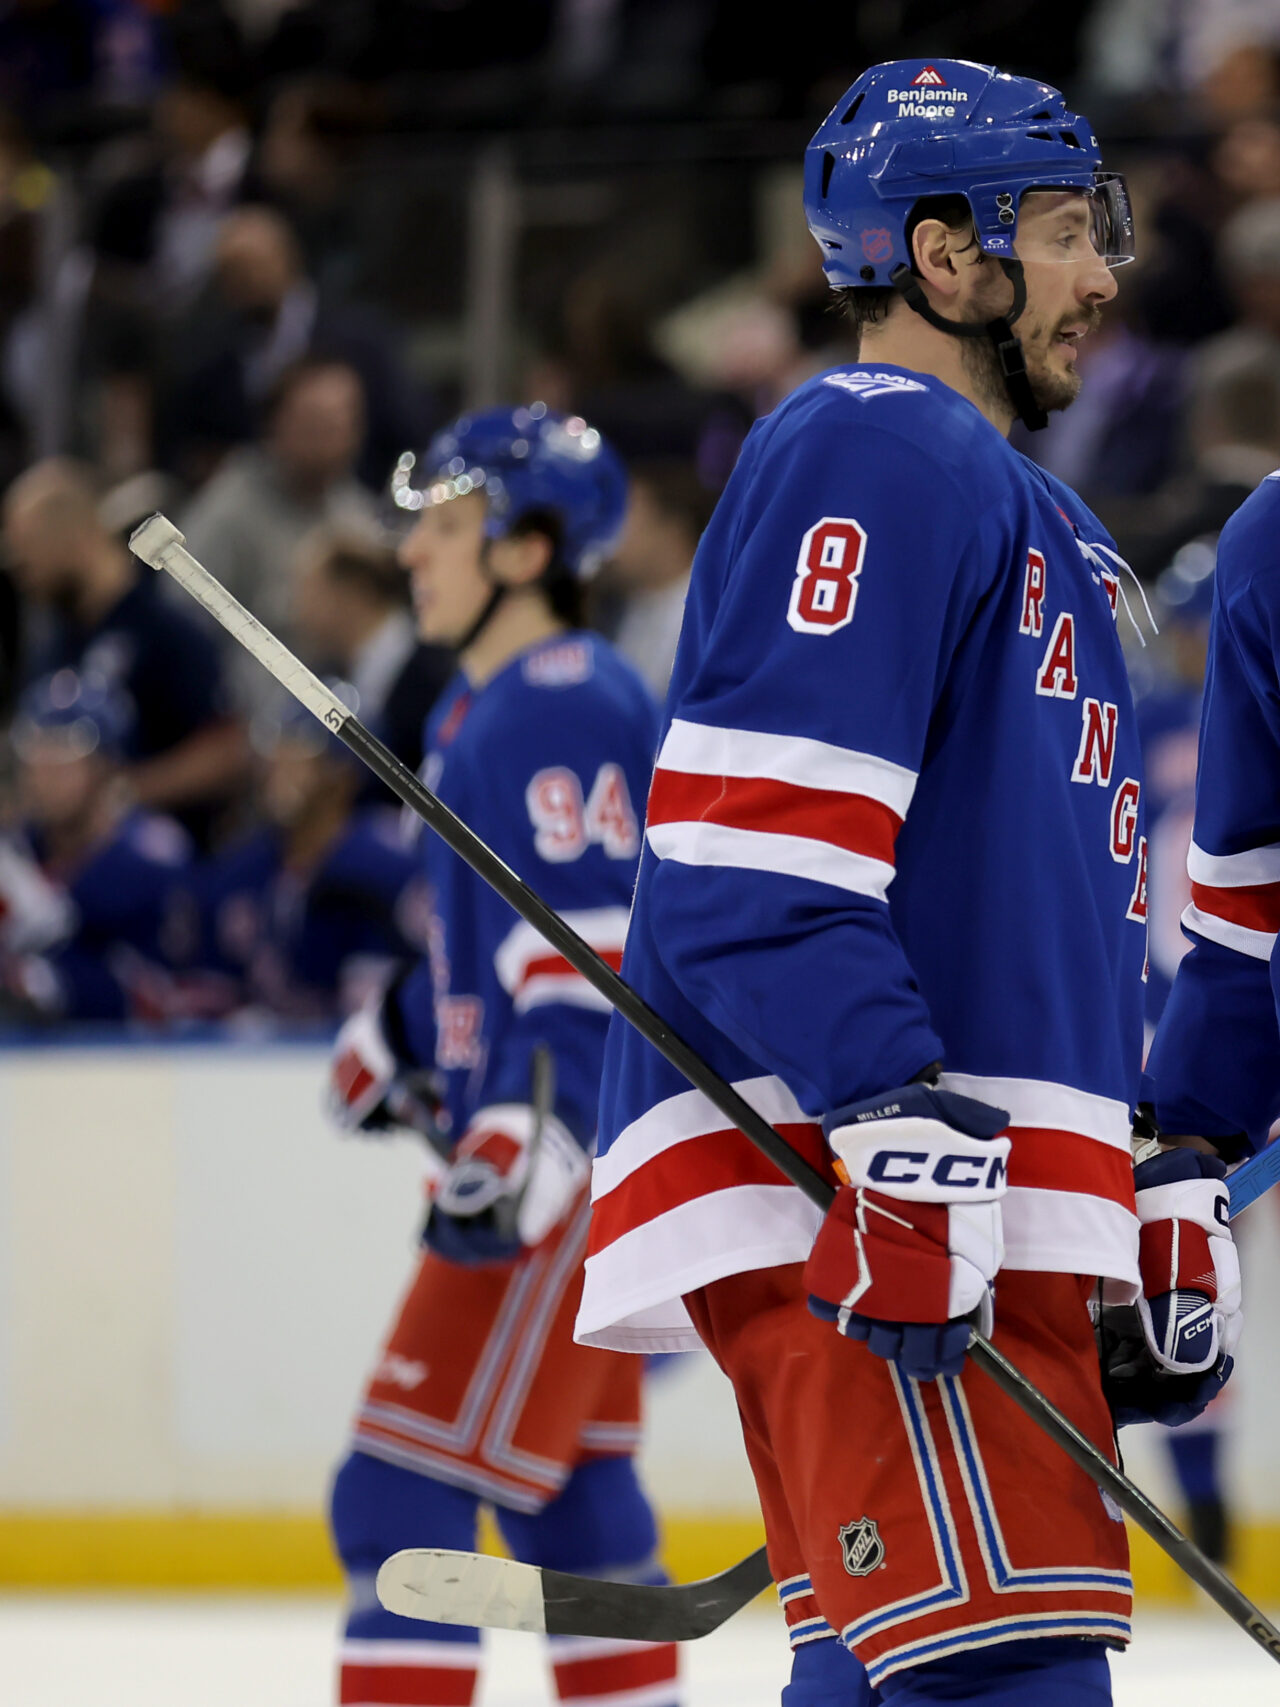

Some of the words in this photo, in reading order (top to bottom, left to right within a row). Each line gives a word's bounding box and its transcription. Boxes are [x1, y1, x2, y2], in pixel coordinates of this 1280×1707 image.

[887, 87, 968, 105] Benjamin
[898, 102, 955, 117] Moore
[786, 516, 868, 636] 8
[526, 762, 640, 863] 94
[856, 1103, 901, 1122] MILLER
[851, 1531, 873, 1569] NHL
